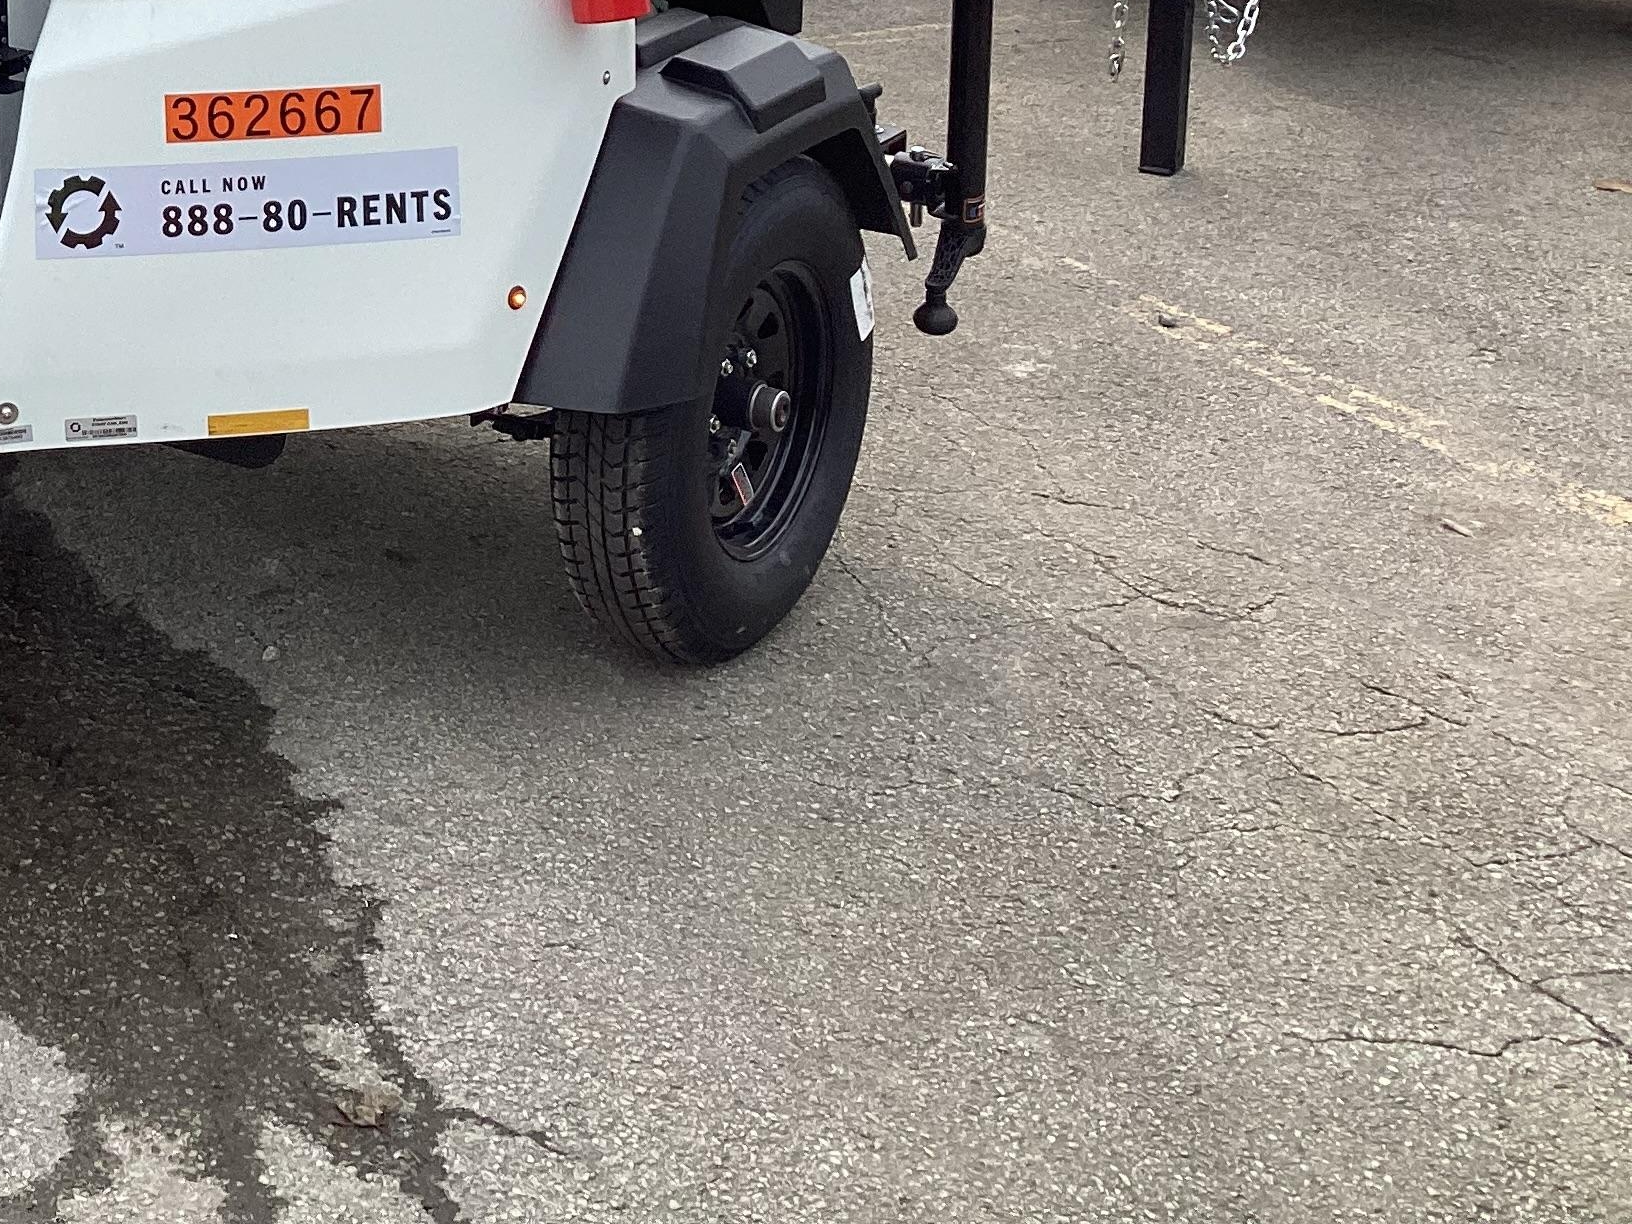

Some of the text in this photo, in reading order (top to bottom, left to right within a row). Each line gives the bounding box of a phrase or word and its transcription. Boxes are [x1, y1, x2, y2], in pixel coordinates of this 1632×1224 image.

[170, 88, 376, 141] 362667
[160, 175, 268, 196] CALL NOW
[161, 187, 453, 239] 888-80-RENTS
